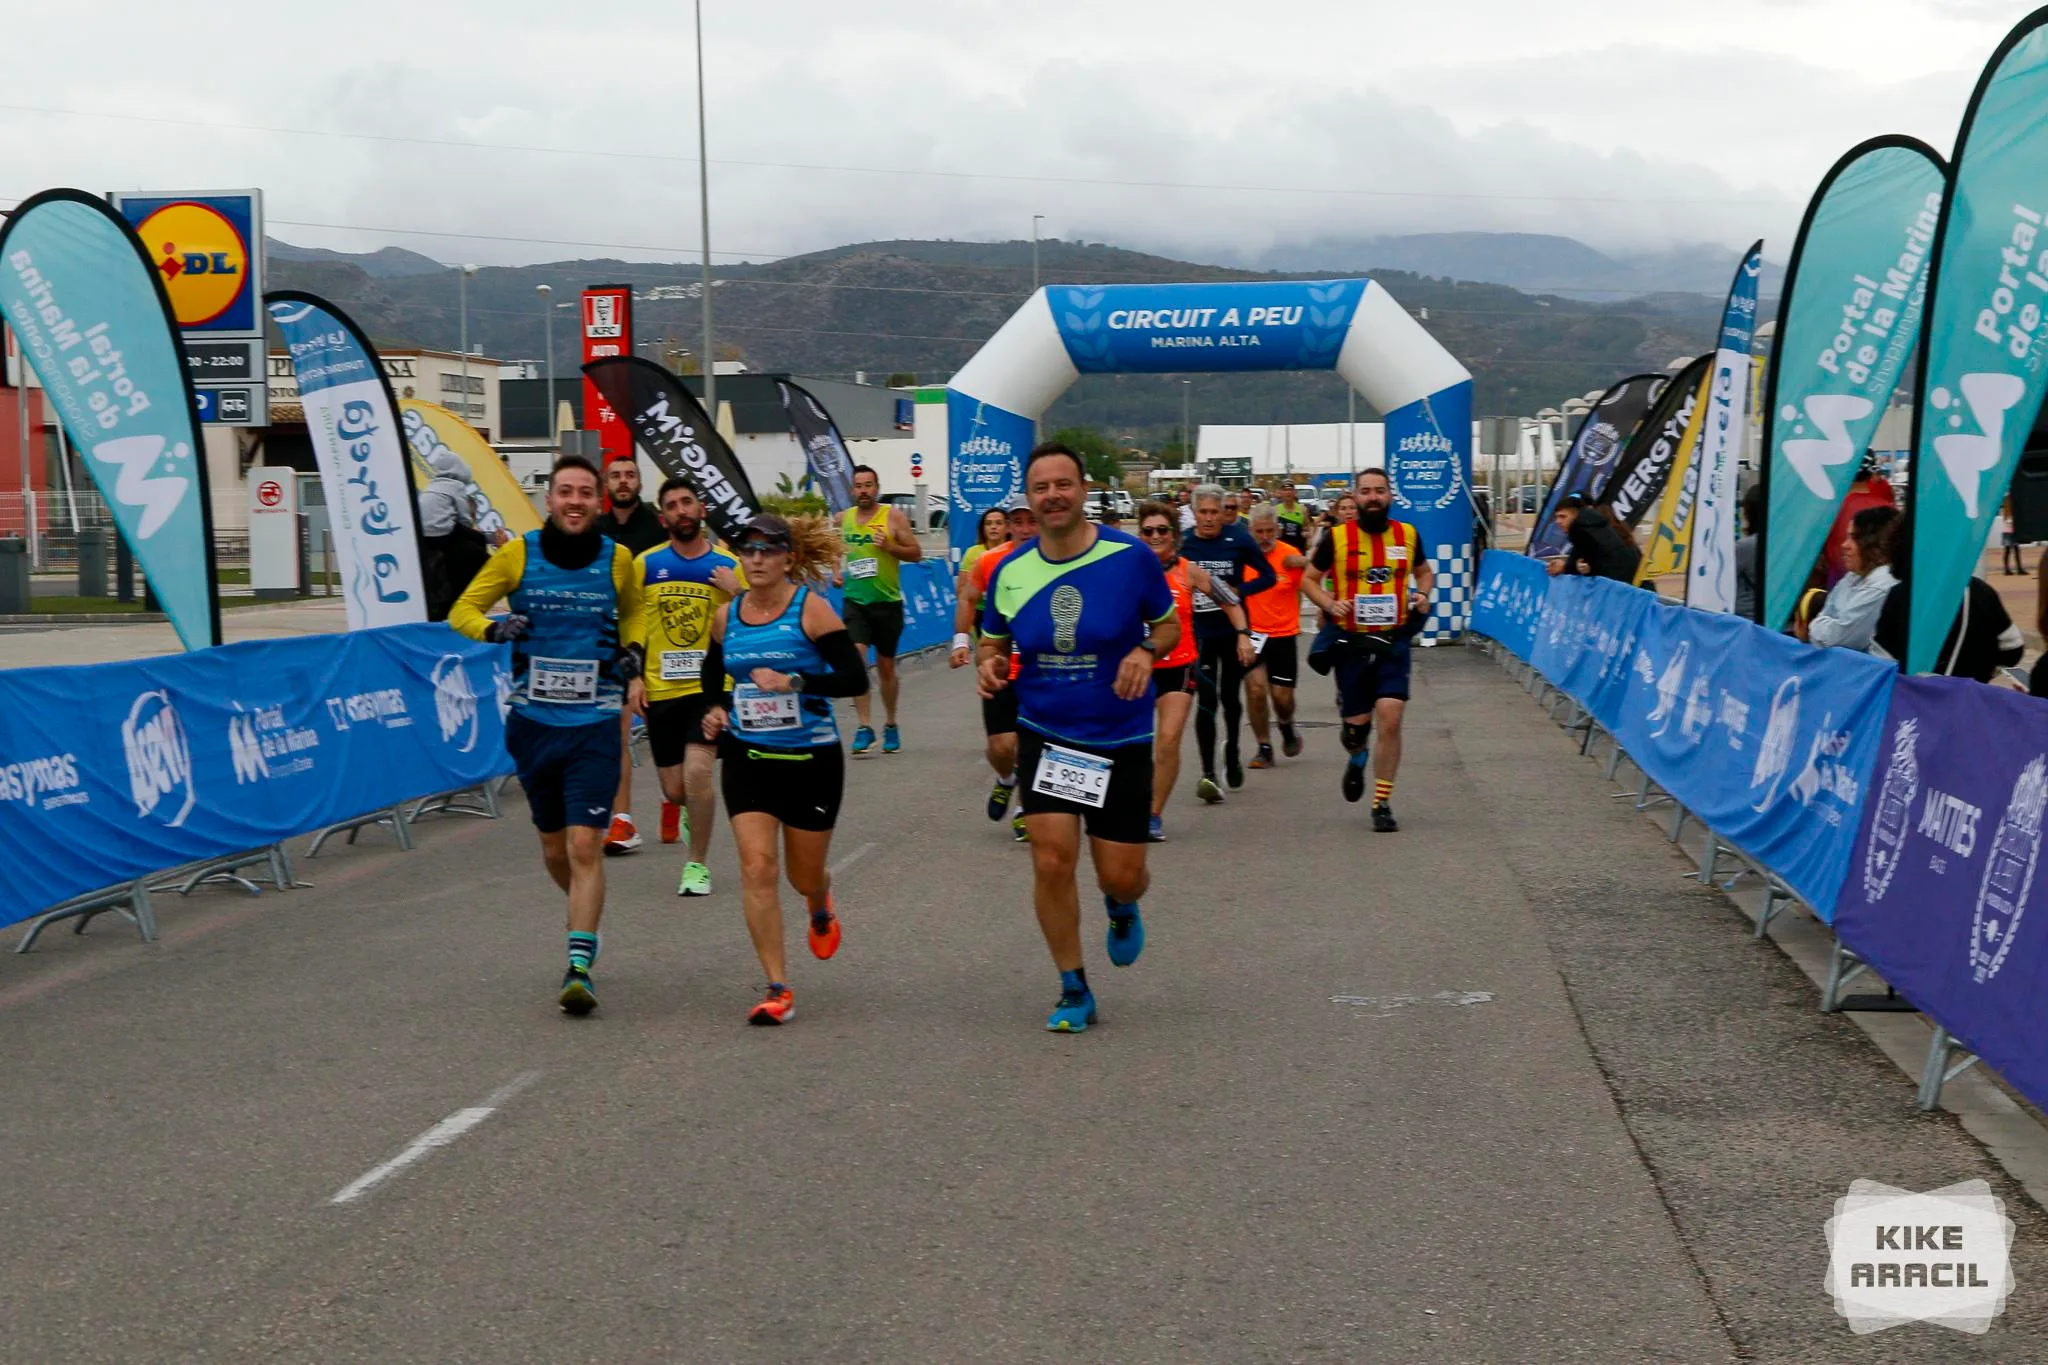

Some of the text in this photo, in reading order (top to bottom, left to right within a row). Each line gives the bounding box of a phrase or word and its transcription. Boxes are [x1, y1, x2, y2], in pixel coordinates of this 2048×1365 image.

[1974, 203, 2041, 344] Portal
[1844, 191, 1943, 385] de la Marina
[1107, 305, 1304, 330] CIRCUIT A PEU
[1817, 273, 1880, 375] Portal
[2007, 303, 2041, 359] de
[1151, 335, 1260, 348] MARINA ALTA
[210, 355, 244, 367] 22:00
[960, 463, 1008, 473] CIRCUIT
[1400, 460, 1448, 470] CIRCUIT
[976, 474, 1002, 483] PEU
[1405, 471, 1442, 480] A PEU
[551, 675, 593, 688] 724 P
[754, 700, 795, 715] 204 E
[1061, 768, 1104, 788] 903 C
